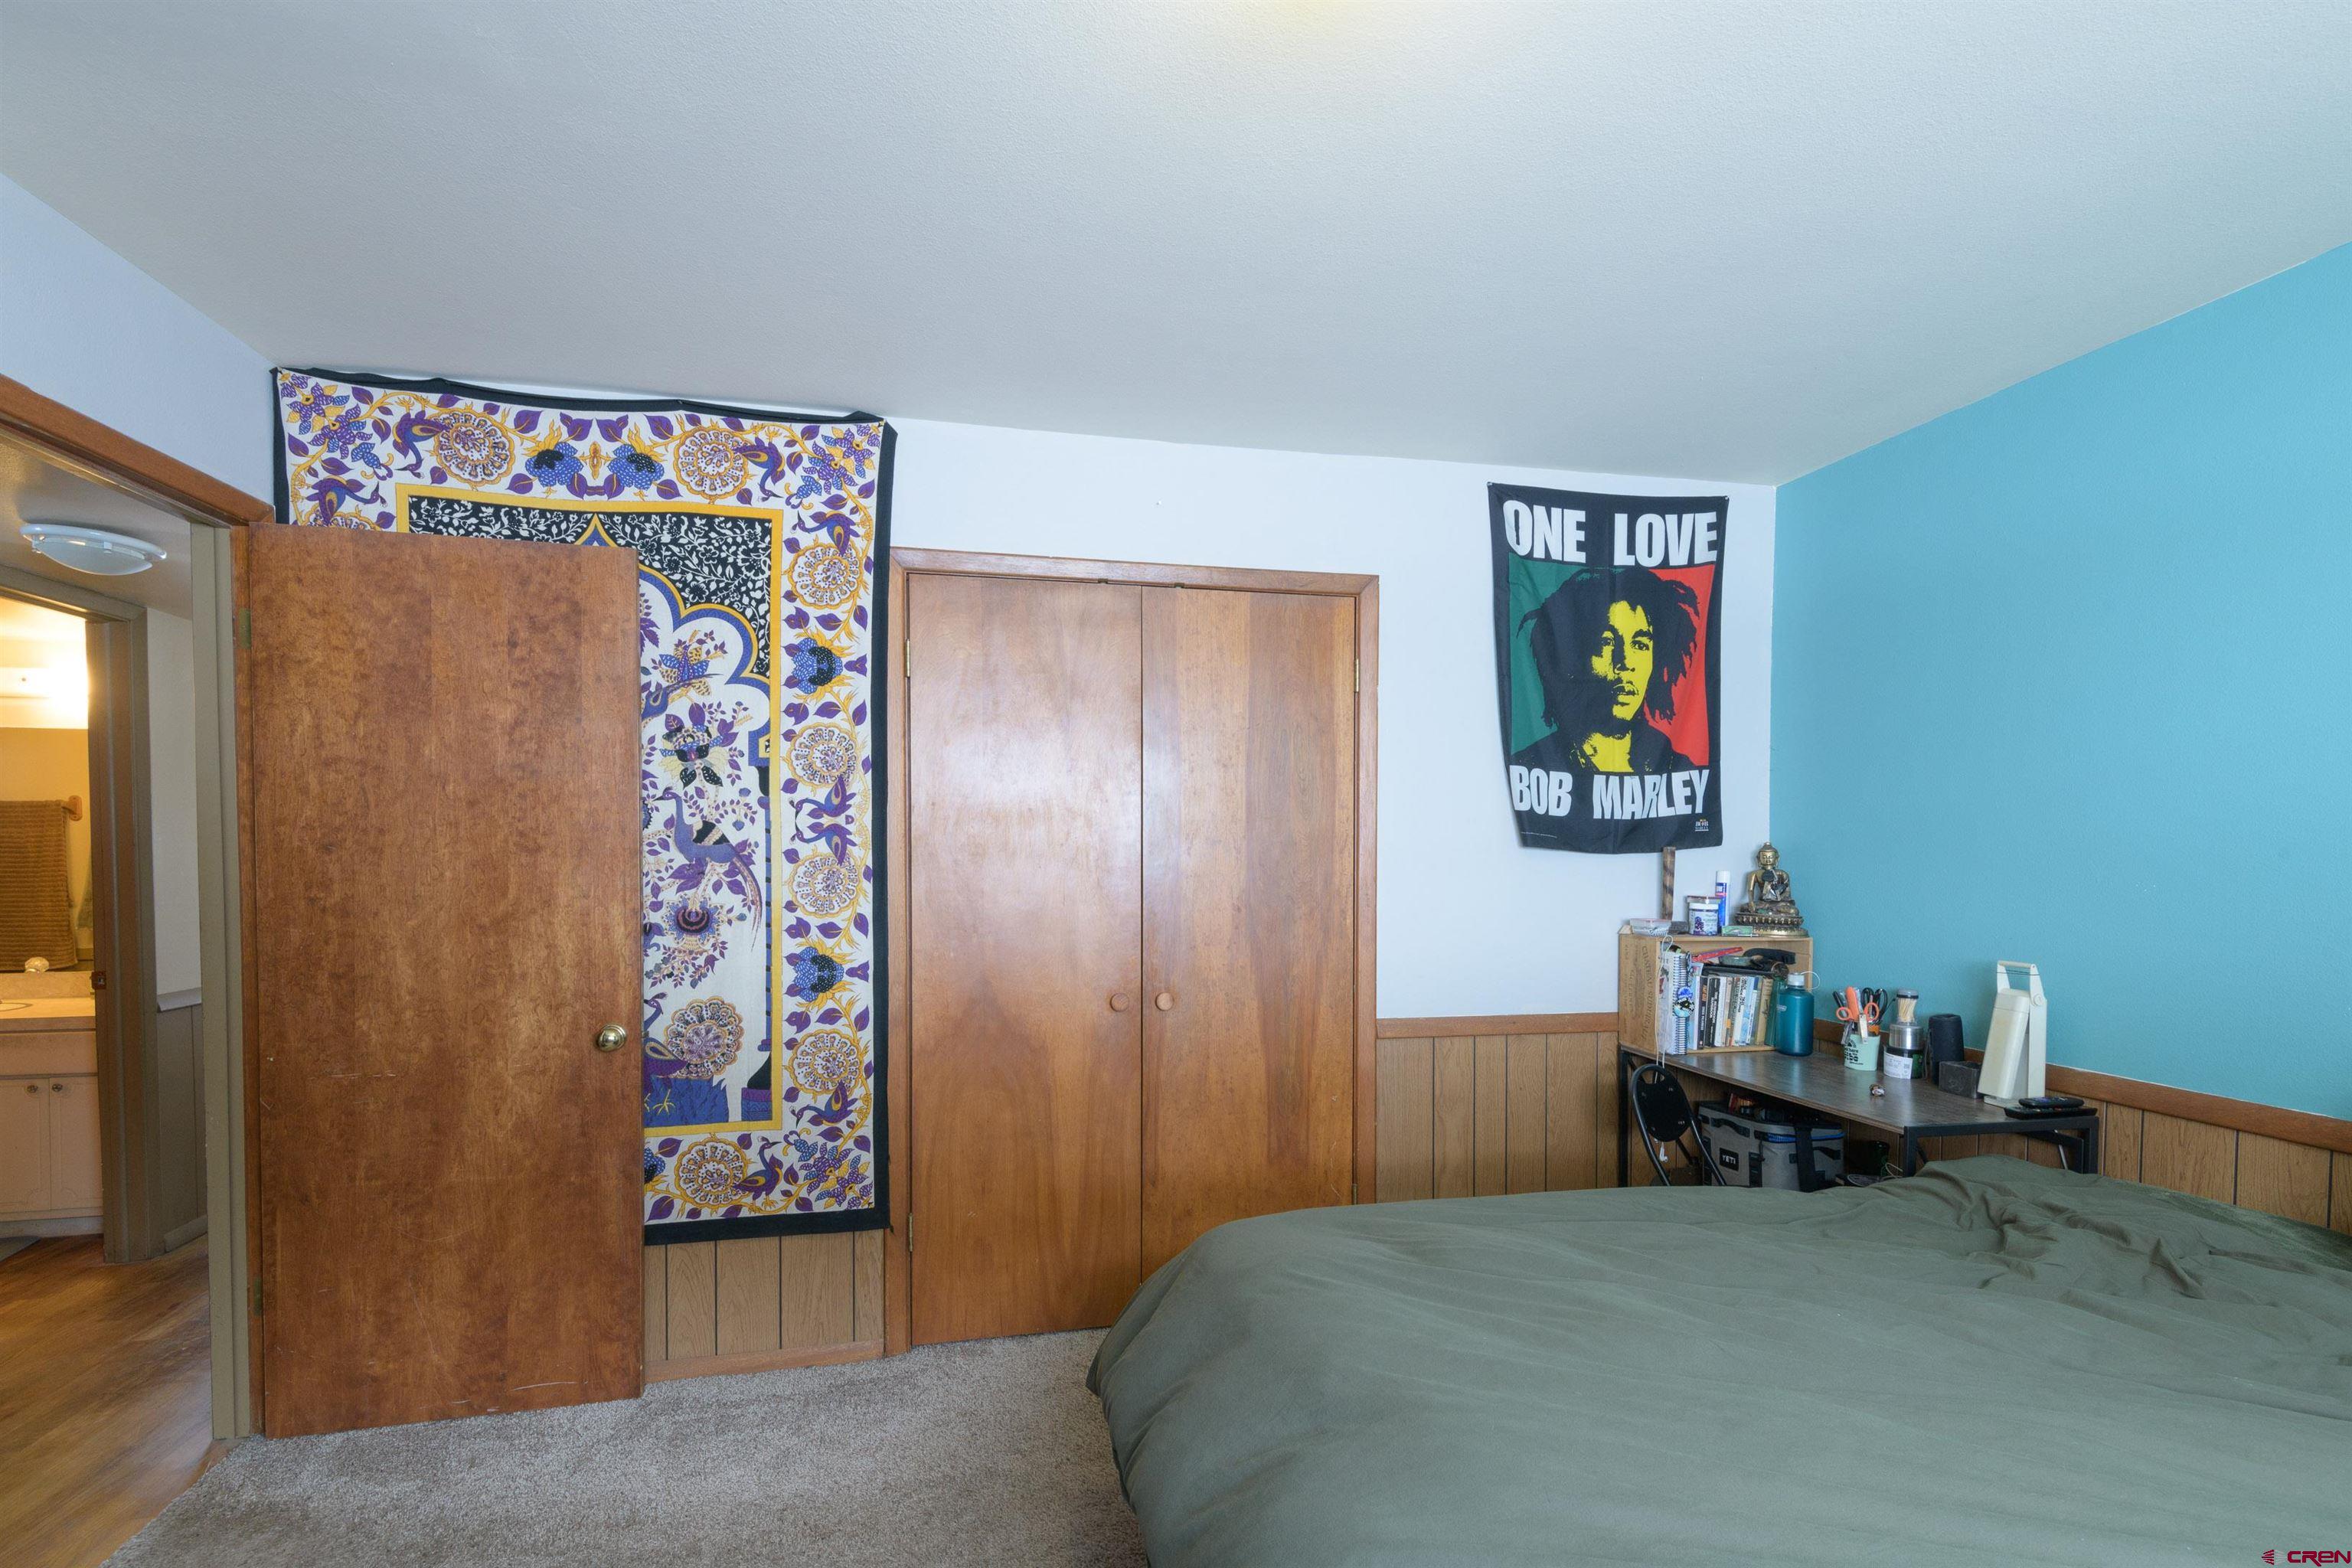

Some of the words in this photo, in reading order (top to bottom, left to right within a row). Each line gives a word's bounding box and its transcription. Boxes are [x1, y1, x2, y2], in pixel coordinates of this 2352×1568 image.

[1503, 500, 1586, 564] ONE
[1614, 512, 1717, 567] LOVE
[1509, 765, 1573, 817] BOB
[1592, 769, 1710, 820] MARLEY
[1723, 1155, 1736, 1165] YETI
